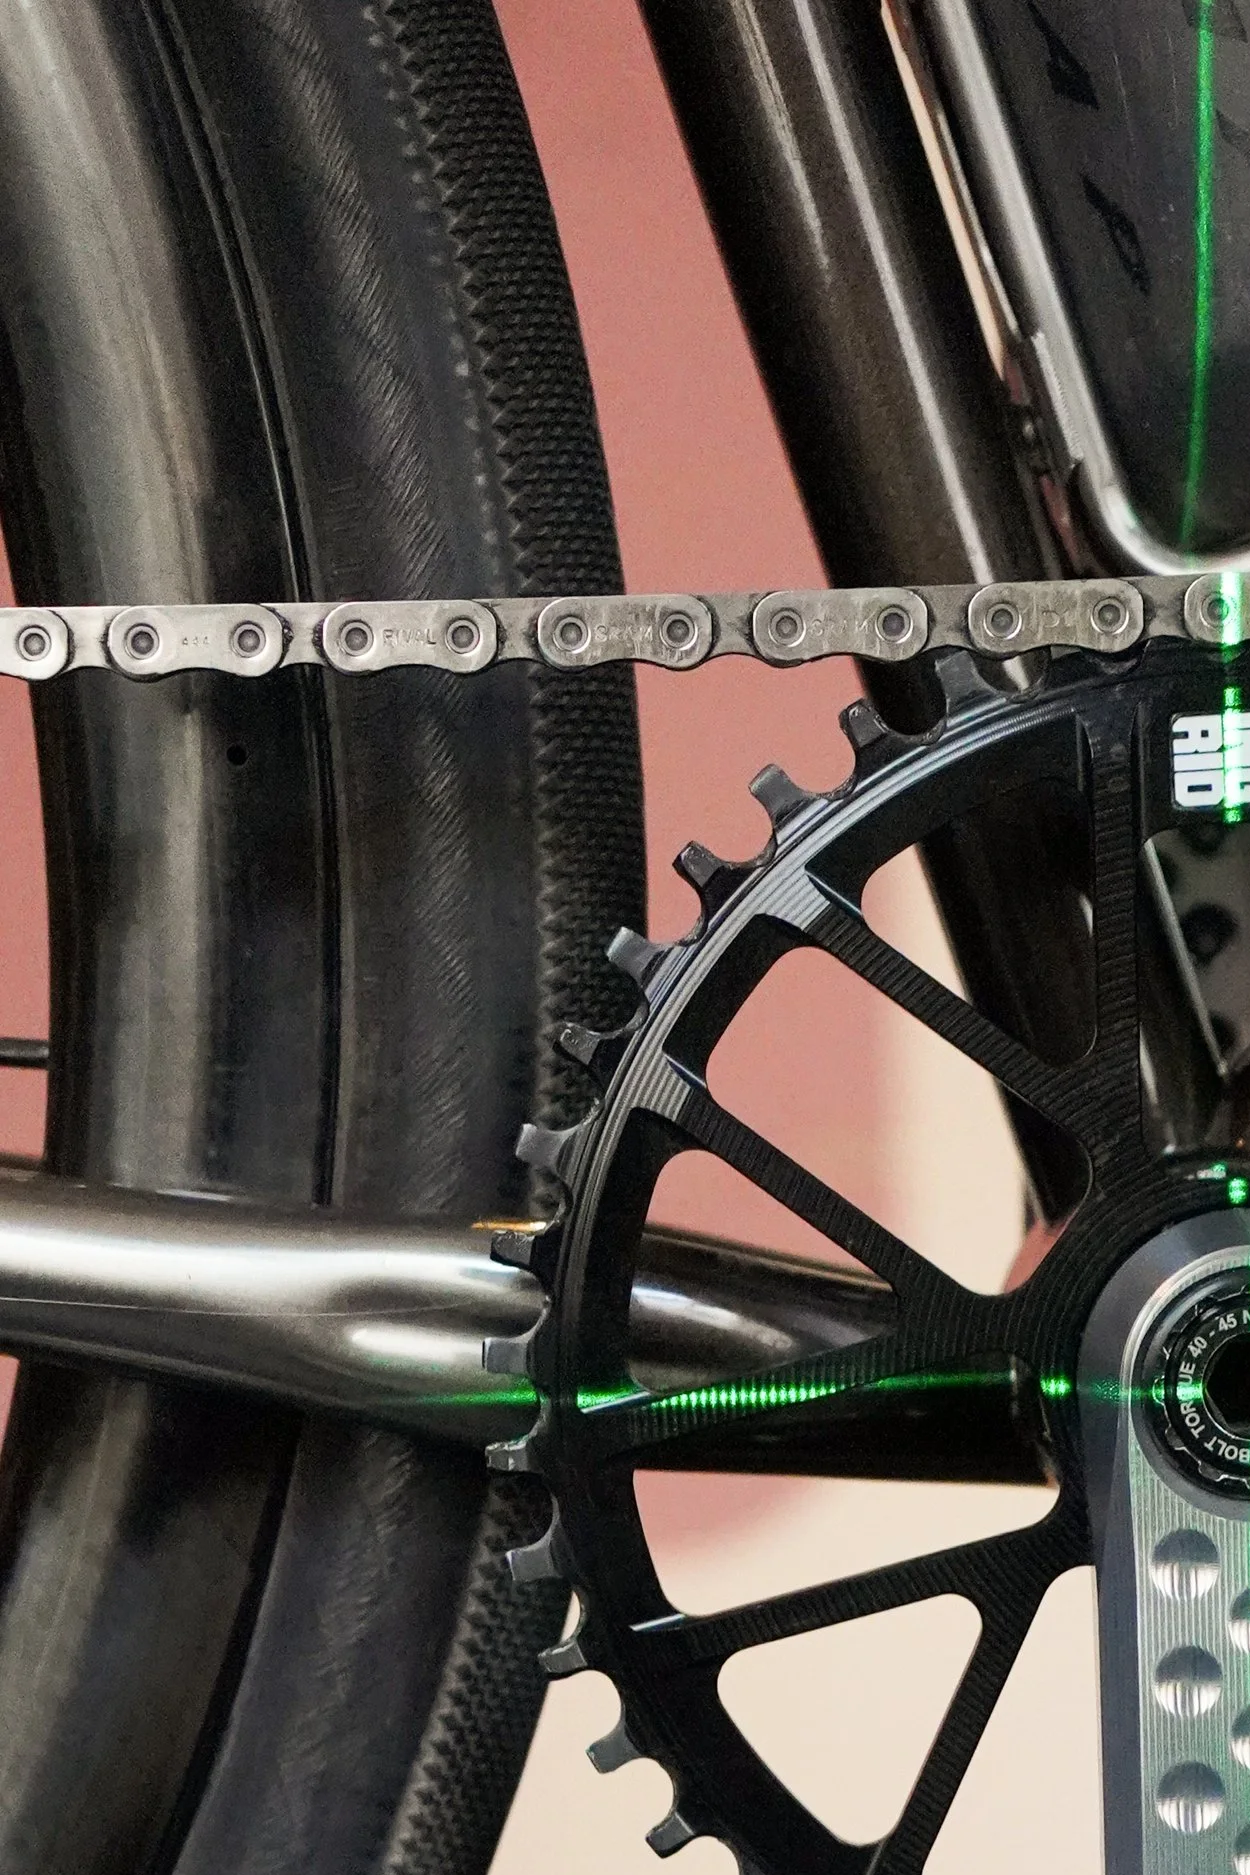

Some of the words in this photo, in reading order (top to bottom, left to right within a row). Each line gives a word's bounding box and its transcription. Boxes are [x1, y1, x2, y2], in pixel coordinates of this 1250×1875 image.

[382, 628, 437, 647] RIVAL
[1217, 1312, 1238, 1331] 45
[1187, 1336, 1208, 1358] 40
[1179, 1361, 1206, 1439] TORUE
[1203, 1435, 1250, 1464] BOLT
